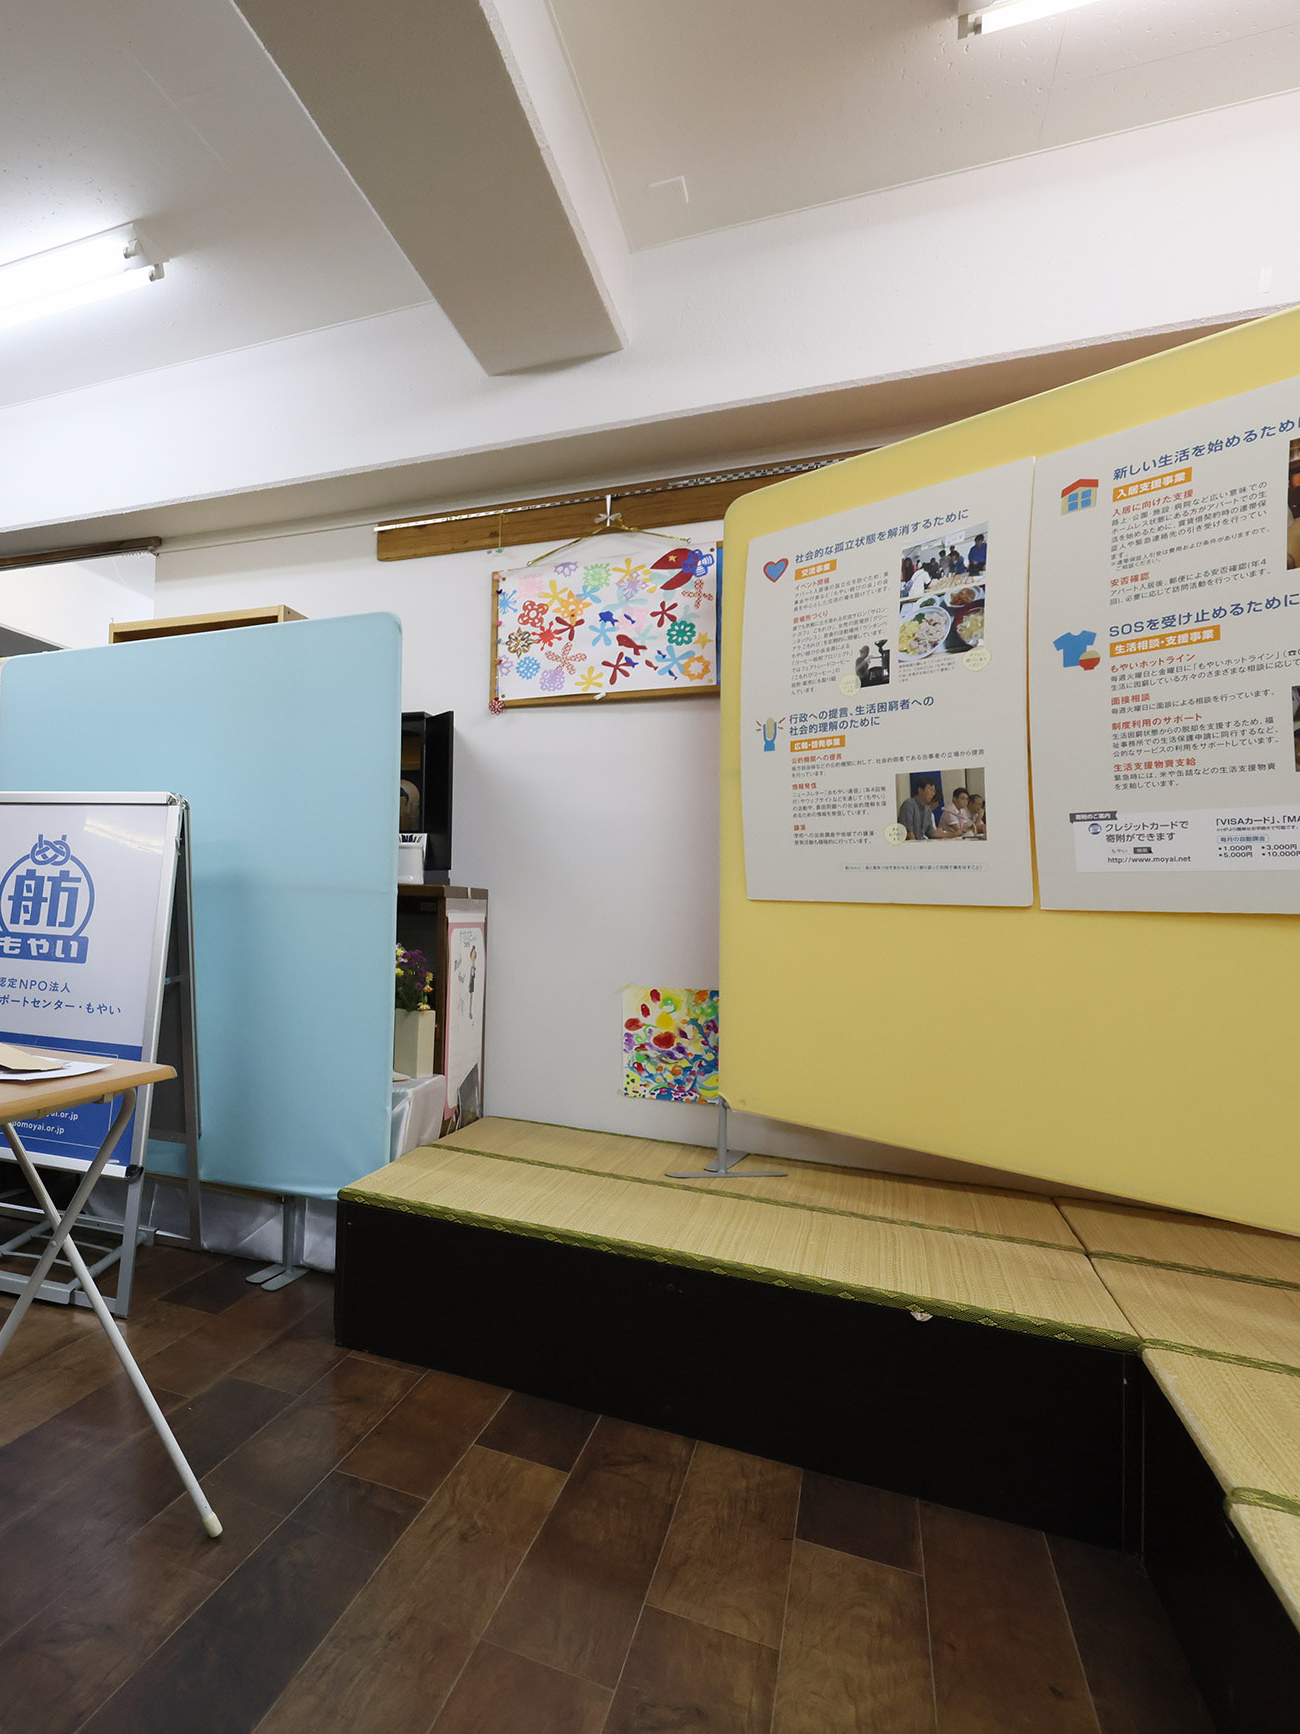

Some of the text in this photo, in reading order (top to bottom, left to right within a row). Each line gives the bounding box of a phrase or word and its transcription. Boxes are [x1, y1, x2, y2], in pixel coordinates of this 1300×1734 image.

[1113, 416, 1300, 481] 新しい生活を始めるため
[1116, 471, 1187, 499] 入居支援事業
[1112, 489, 1194, 517] 入居に向けた支援
[794, 508, 971, 563] 社会的な孤立状態を解消するために
[1110, 572, 1150, 588] 安否確認
[1109, 593, 1300, 637] SOSを受け止めるために
[1114, 629, 1215, 655] 生活相談・支援事業
[1110, 653, 1196, 673] もやいホットライン
[1110, 693, 1151, 706] 面接相談
[789, 696, 935, 724] 行政への提言、生活困窮者への
[789, 715, 881, 736] 社会的理解のために
[1111, 713, 1203, 731] 制度利用のサポート
[791, 753, 843, 764] 公的機関への提言
[1113, 757, 1197, 772] 生活支援物資支給
[1105, 820, 1189, 832] クレジットカードで
[1105, 832, 1176, 843] 寄附ができます
[1107, 855, 1192, 864] http://www.moyai.net
[7, 868, 82, 928] 舫
